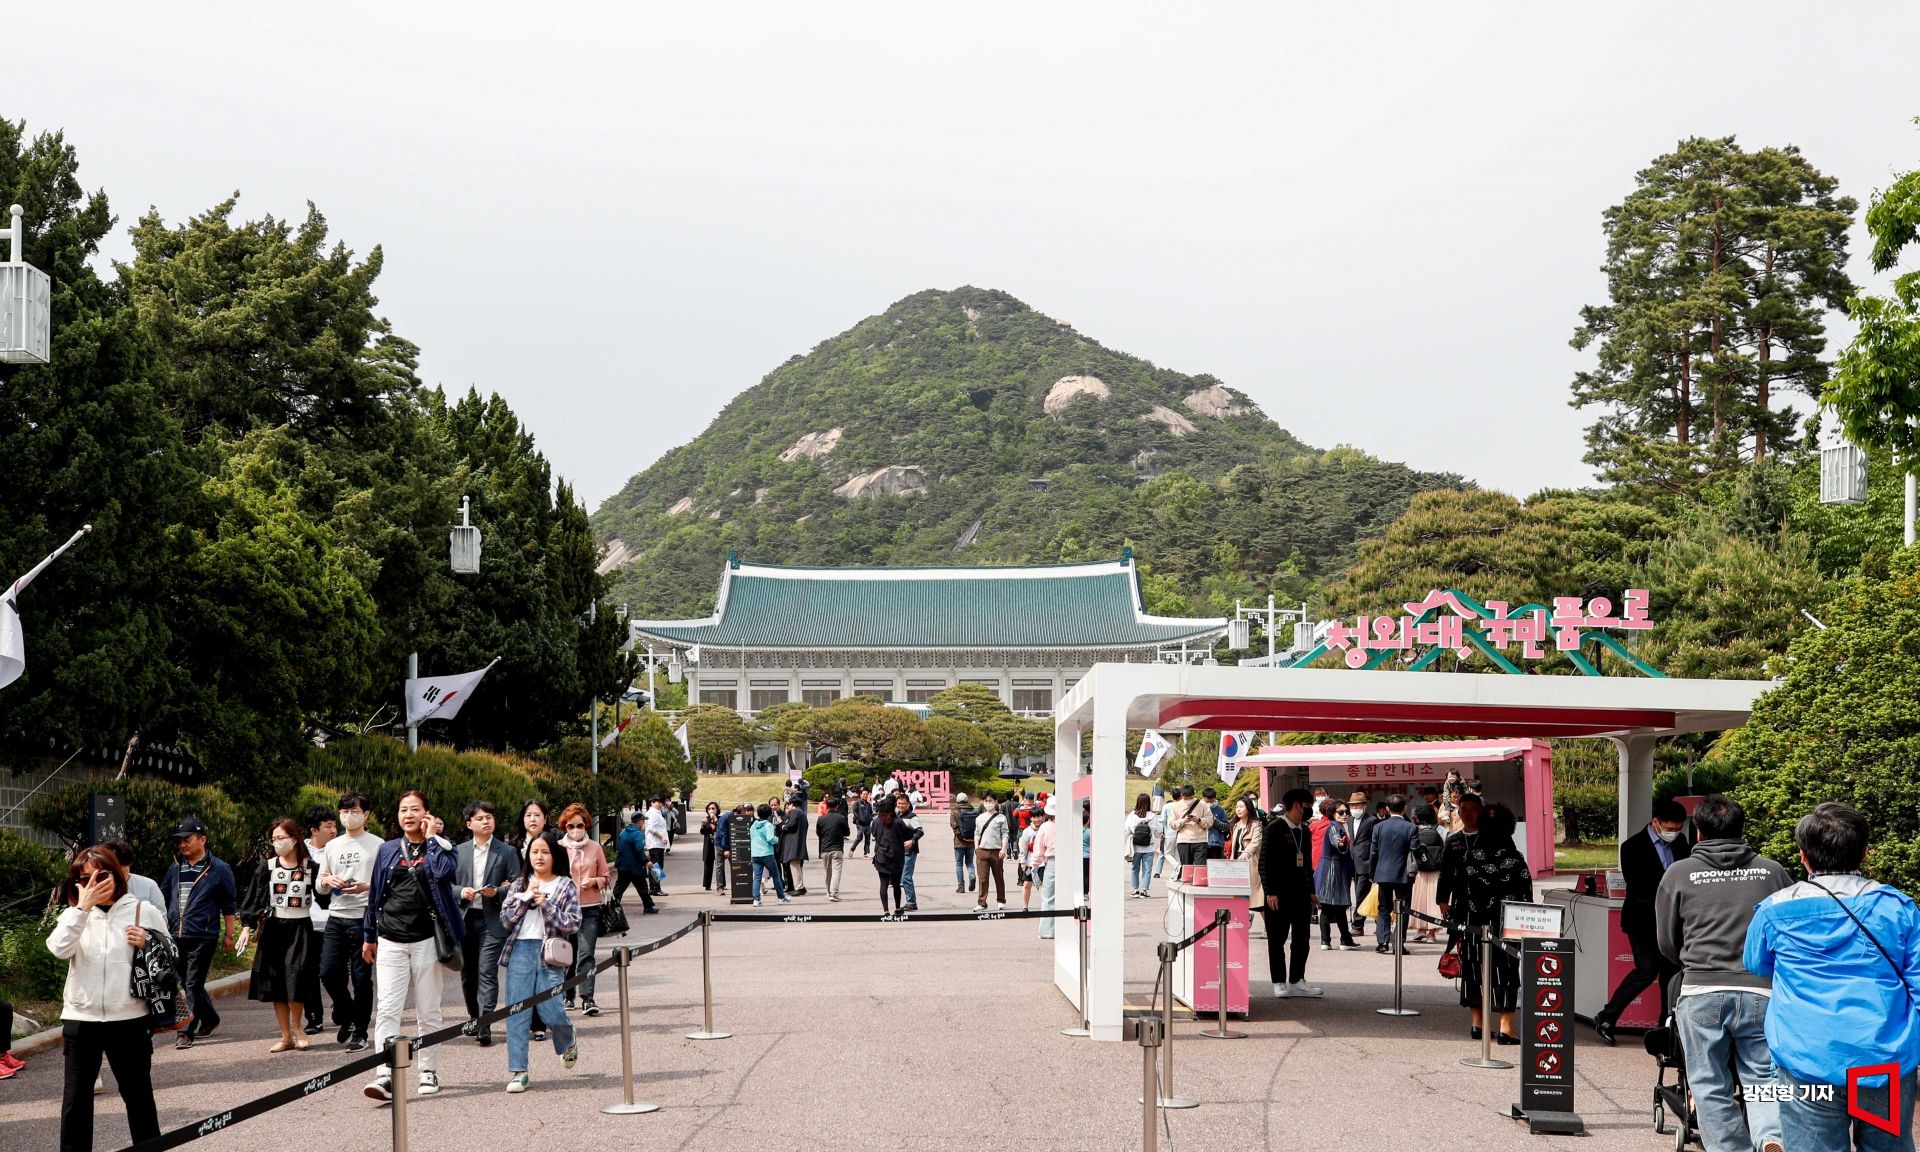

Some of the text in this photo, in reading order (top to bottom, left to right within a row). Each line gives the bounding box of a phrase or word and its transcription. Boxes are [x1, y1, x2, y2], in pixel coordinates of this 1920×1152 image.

[1480, 600, 1546, 659] 국민
[1551, 588, 1655, 652] 품으로
[1689, 867, 1771, 881] grooverhyme.
